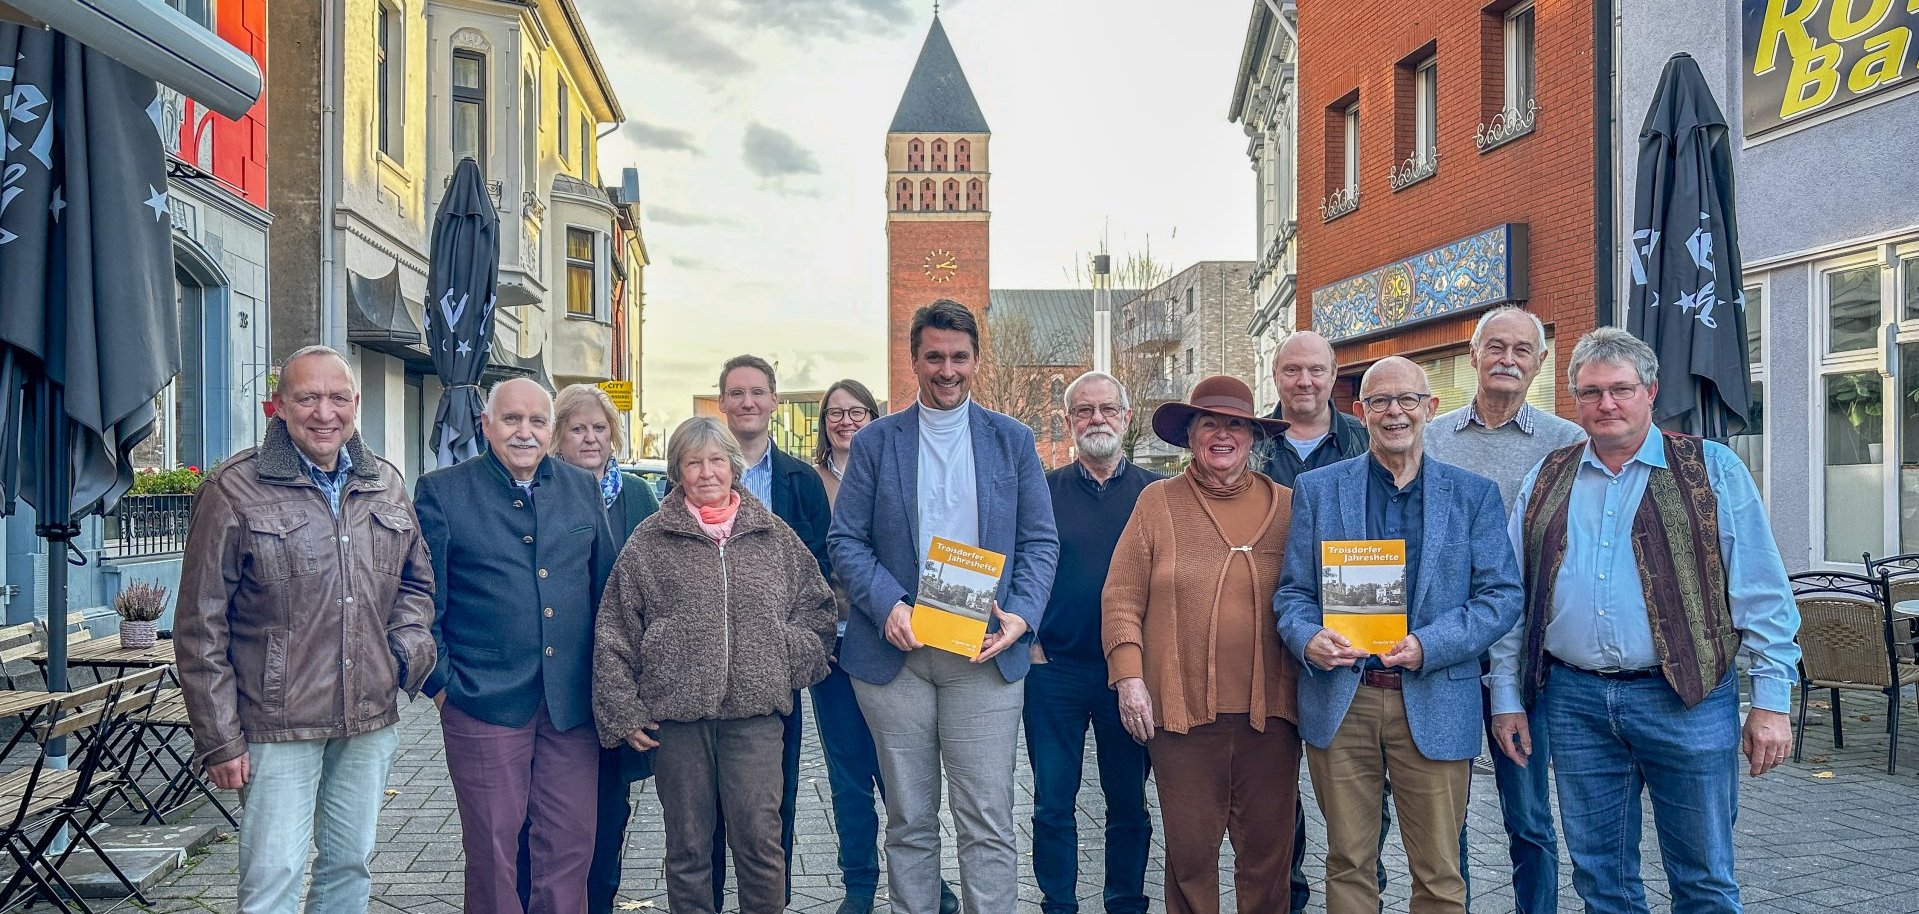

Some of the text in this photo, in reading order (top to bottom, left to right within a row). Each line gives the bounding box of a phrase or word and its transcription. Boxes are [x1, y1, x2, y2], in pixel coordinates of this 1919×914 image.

[1753, 0, 1919, 76] Ro
[1779, 26, 1919, 120] Ba
[937, 542, 984, 561] Troisdorfer
[1328, 546, 1382, 554] Troisdorfer
[1344, 554, 1400, 563] Jahreshefte
[948, 553, 997, 573] Jahreshefte
